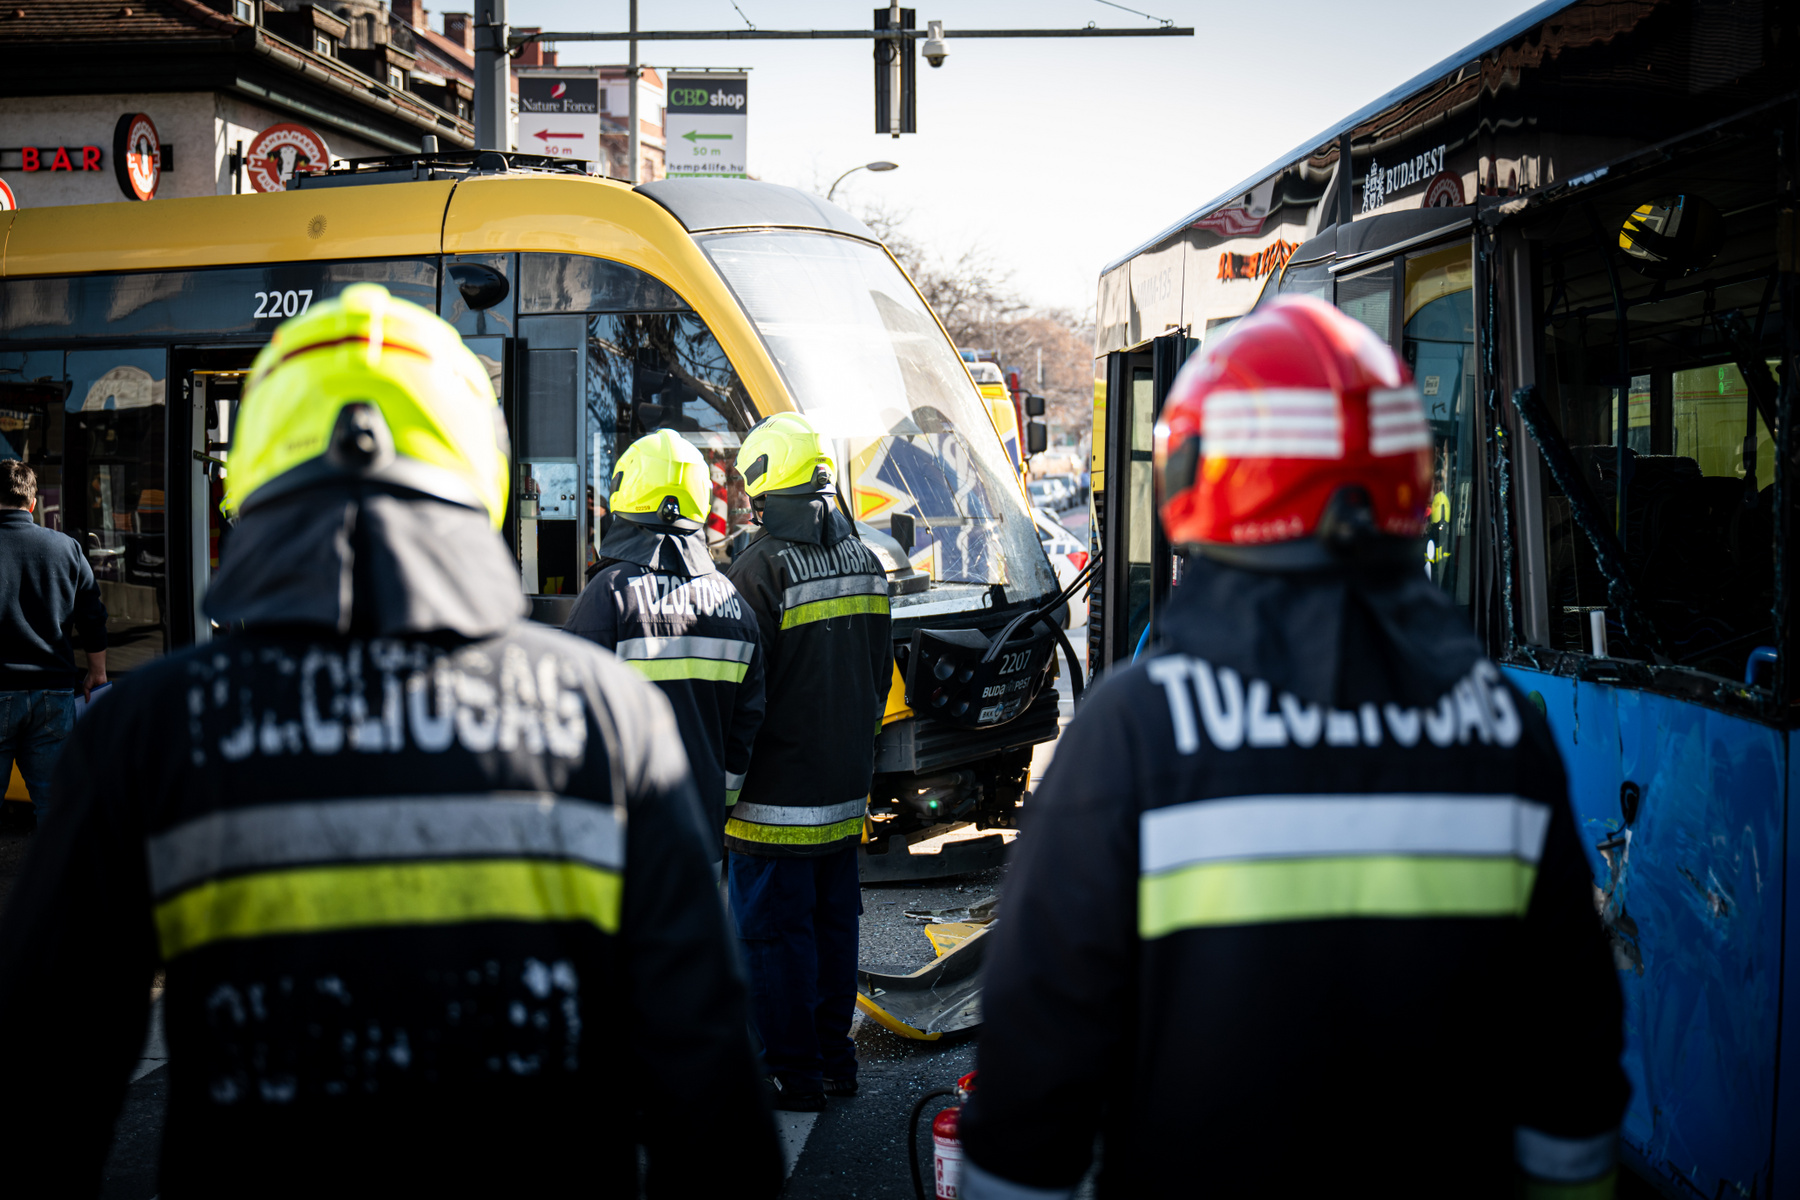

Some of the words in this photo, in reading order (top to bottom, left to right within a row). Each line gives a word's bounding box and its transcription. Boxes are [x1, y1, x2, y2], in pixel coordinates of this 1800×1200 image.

[522, 98, 560, 112] Nature
[563, 98, 596, 112] Force
[670, 88, 709, 106] CBD
[709, 88, 745, 110] shop
[22, 146, 101, 172] BAR
[545, 146, 559, 155] 50
[562, 147, 573, 155] m
[693, 146, 708, 156] 50
[710, 148, 721, 156] m
[669, 163, 744, 172] hemp4life.hu
[1385, 144, 1446, 195] BUDAPEST
[253, 289, 313, 318] 2207
[999, 649, 1032, 675] 2207
